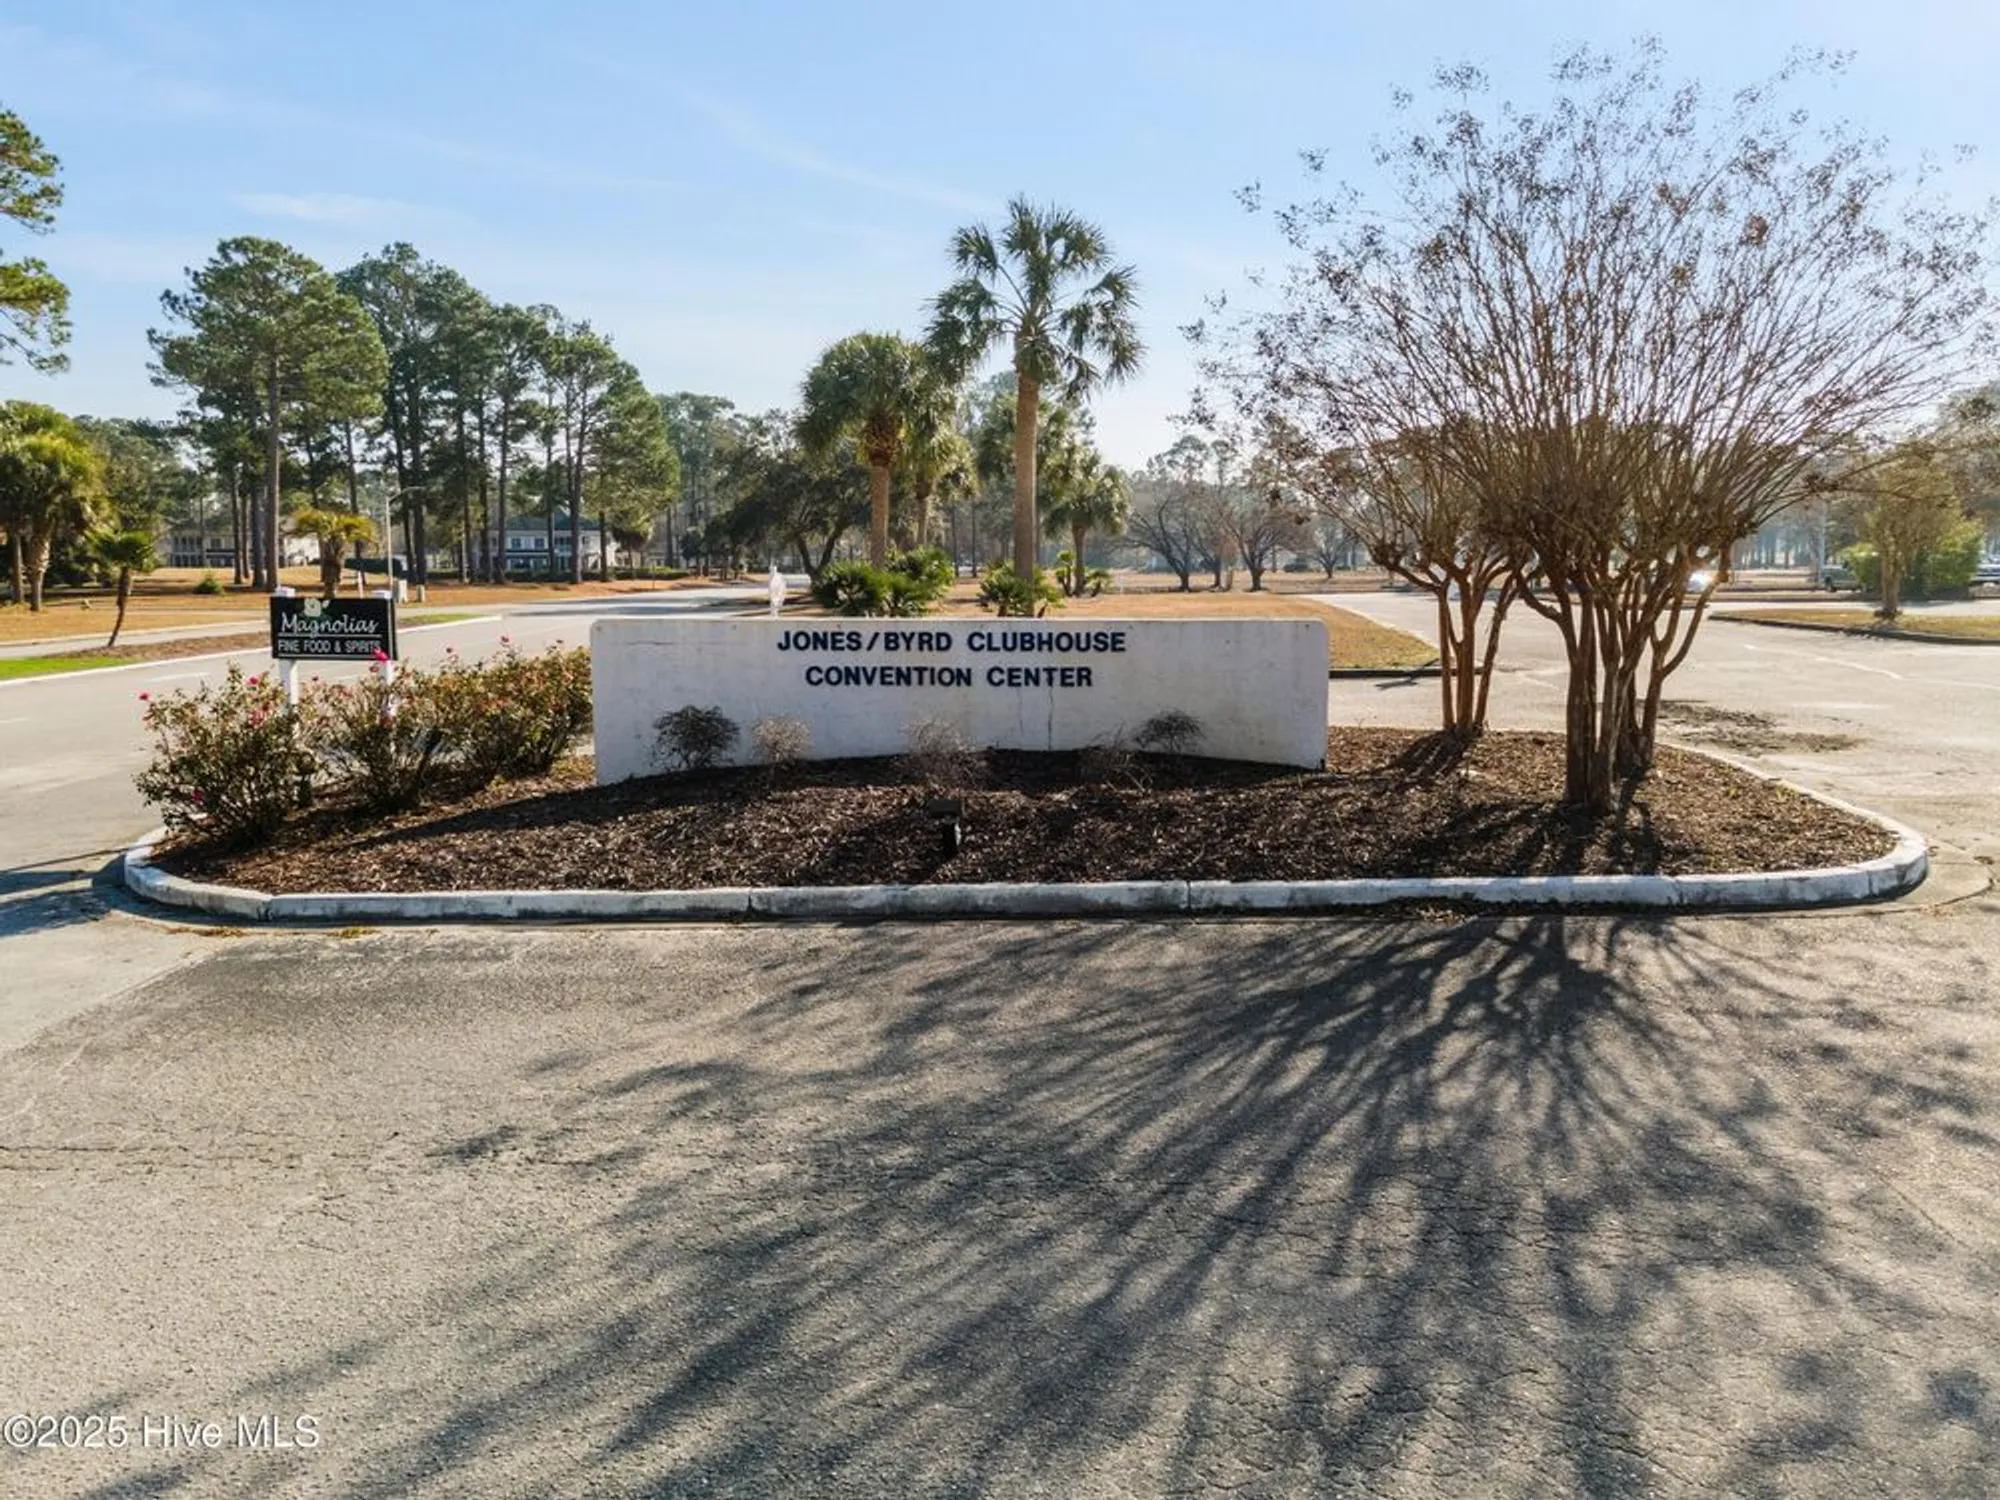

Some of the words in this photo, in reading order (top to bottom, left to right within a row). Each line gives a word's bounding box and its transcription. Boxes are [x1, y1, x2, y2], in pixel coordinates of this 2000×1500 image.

[281, 611, 379, 638] Magnolias
[278, 640, 300, 652] FINE
[303, 640, 331, 652] FOOD
[334, 640, 342, 652] &
[777, 630, 953, 652] JONES/BYRD
[967, 631, 1126, 652] CLUBHOUSE
[805, 665, 972, 687] CONVENTION
[986, 666, 1092, 687] CENTER
